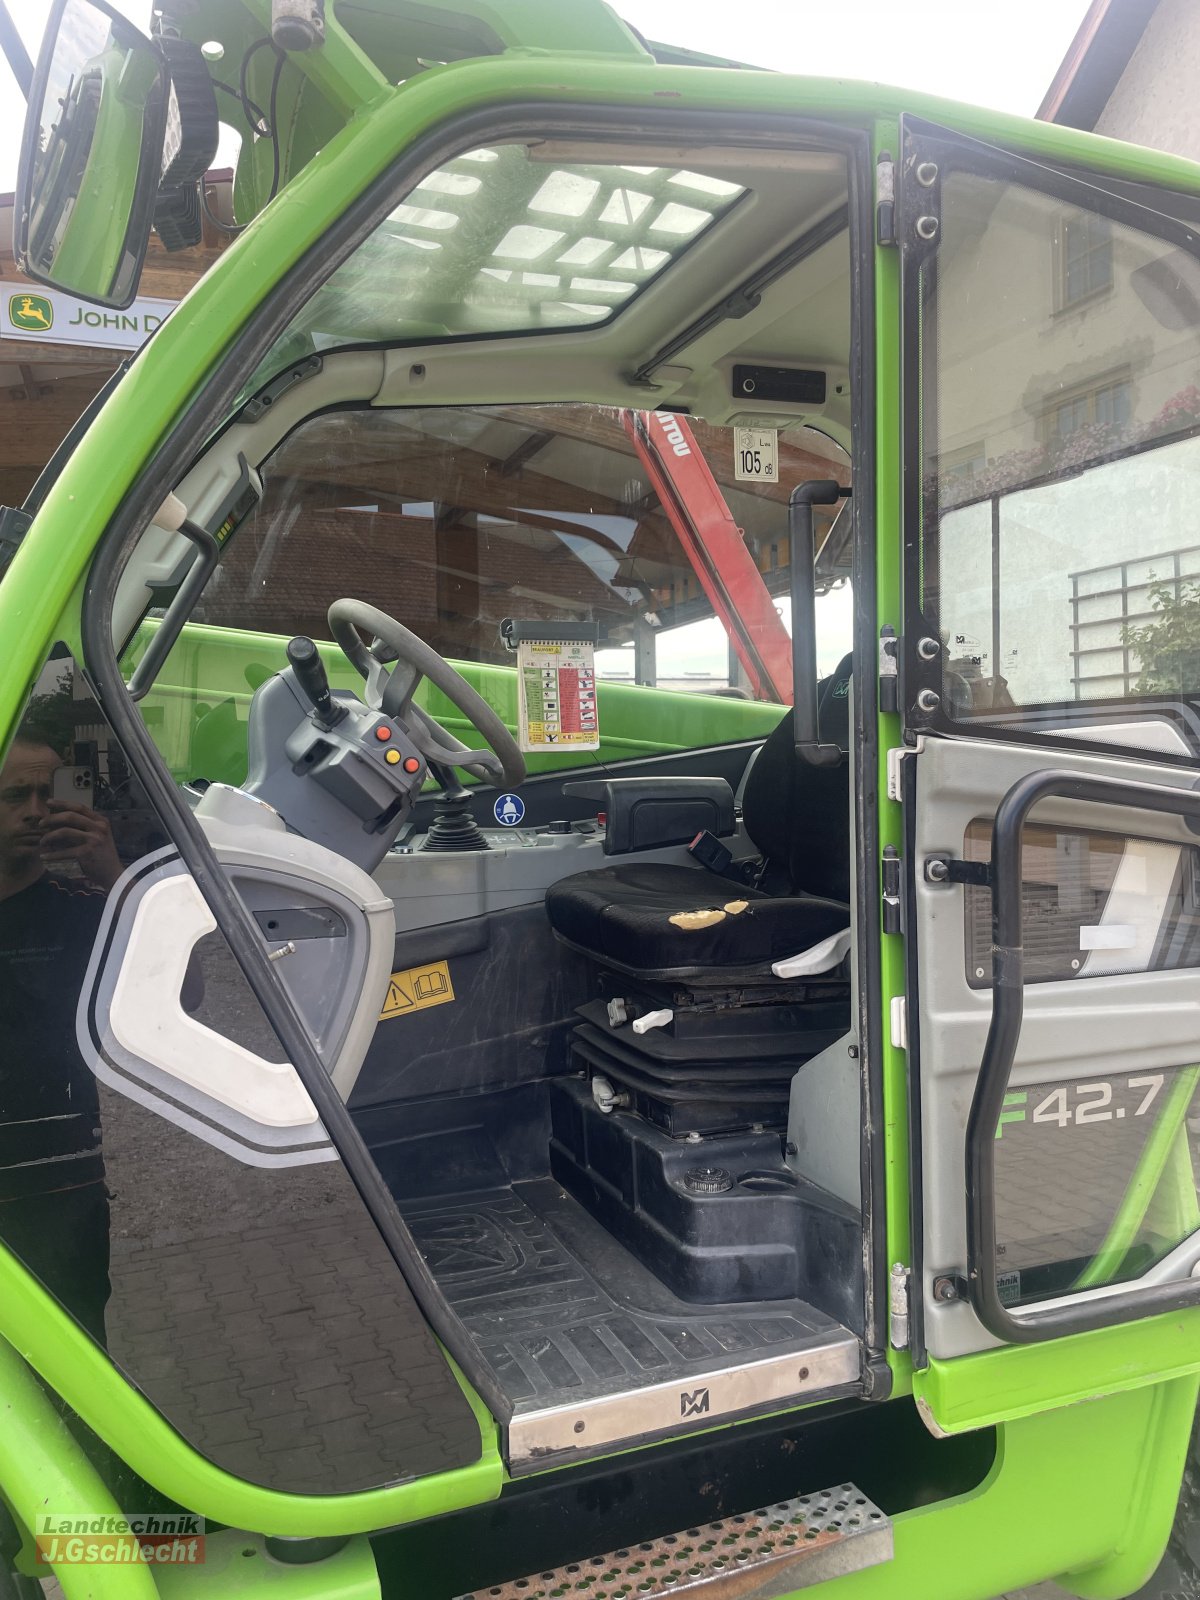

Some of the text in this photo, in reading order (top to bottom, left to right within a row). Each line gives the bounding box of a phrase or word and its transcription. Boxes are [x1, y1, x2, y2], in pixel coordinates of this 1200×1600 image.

[69, 308, 138, 332] JOHN
[655, 411, 692, 457] ITOU
[740, 450, 761, 474] 105
